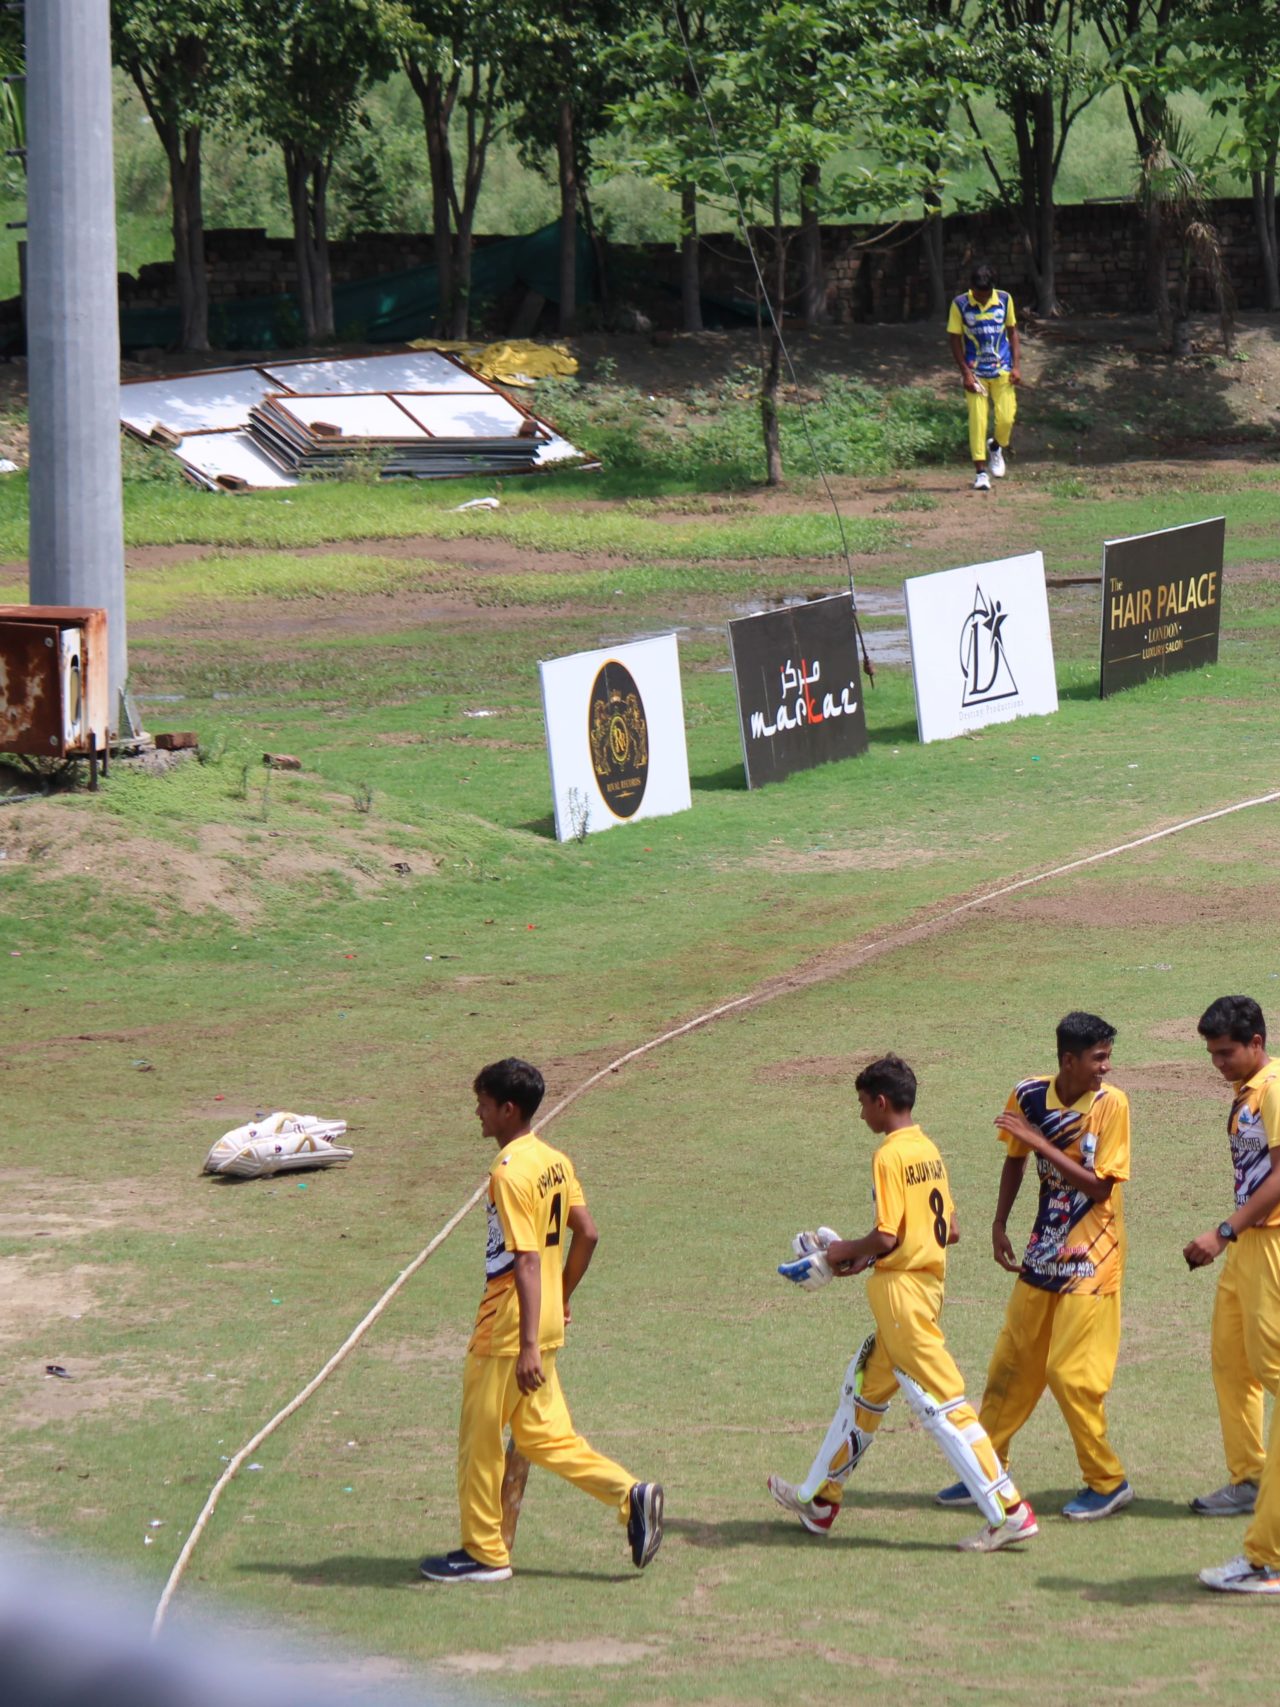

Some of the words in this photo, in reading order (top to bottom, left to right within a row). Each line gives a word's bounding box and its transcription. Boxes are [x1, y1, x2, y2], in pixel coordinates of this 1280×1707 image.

[1110, 577, 1124, 593] The
[1111, 589, 1152, 631] HAIR
[1157, 571, 1217, 619] PALACE
[1148, 622, 1179, 644] LONDON
[1142, 643, 1165, 660] LUXURY
[1165, 640, 1183, 654] SALON
[904, 1161, 931, 1187] ARJUN
[545, 1192, 562, 1248] 4
[929, 1187, 947, 1249] 8
